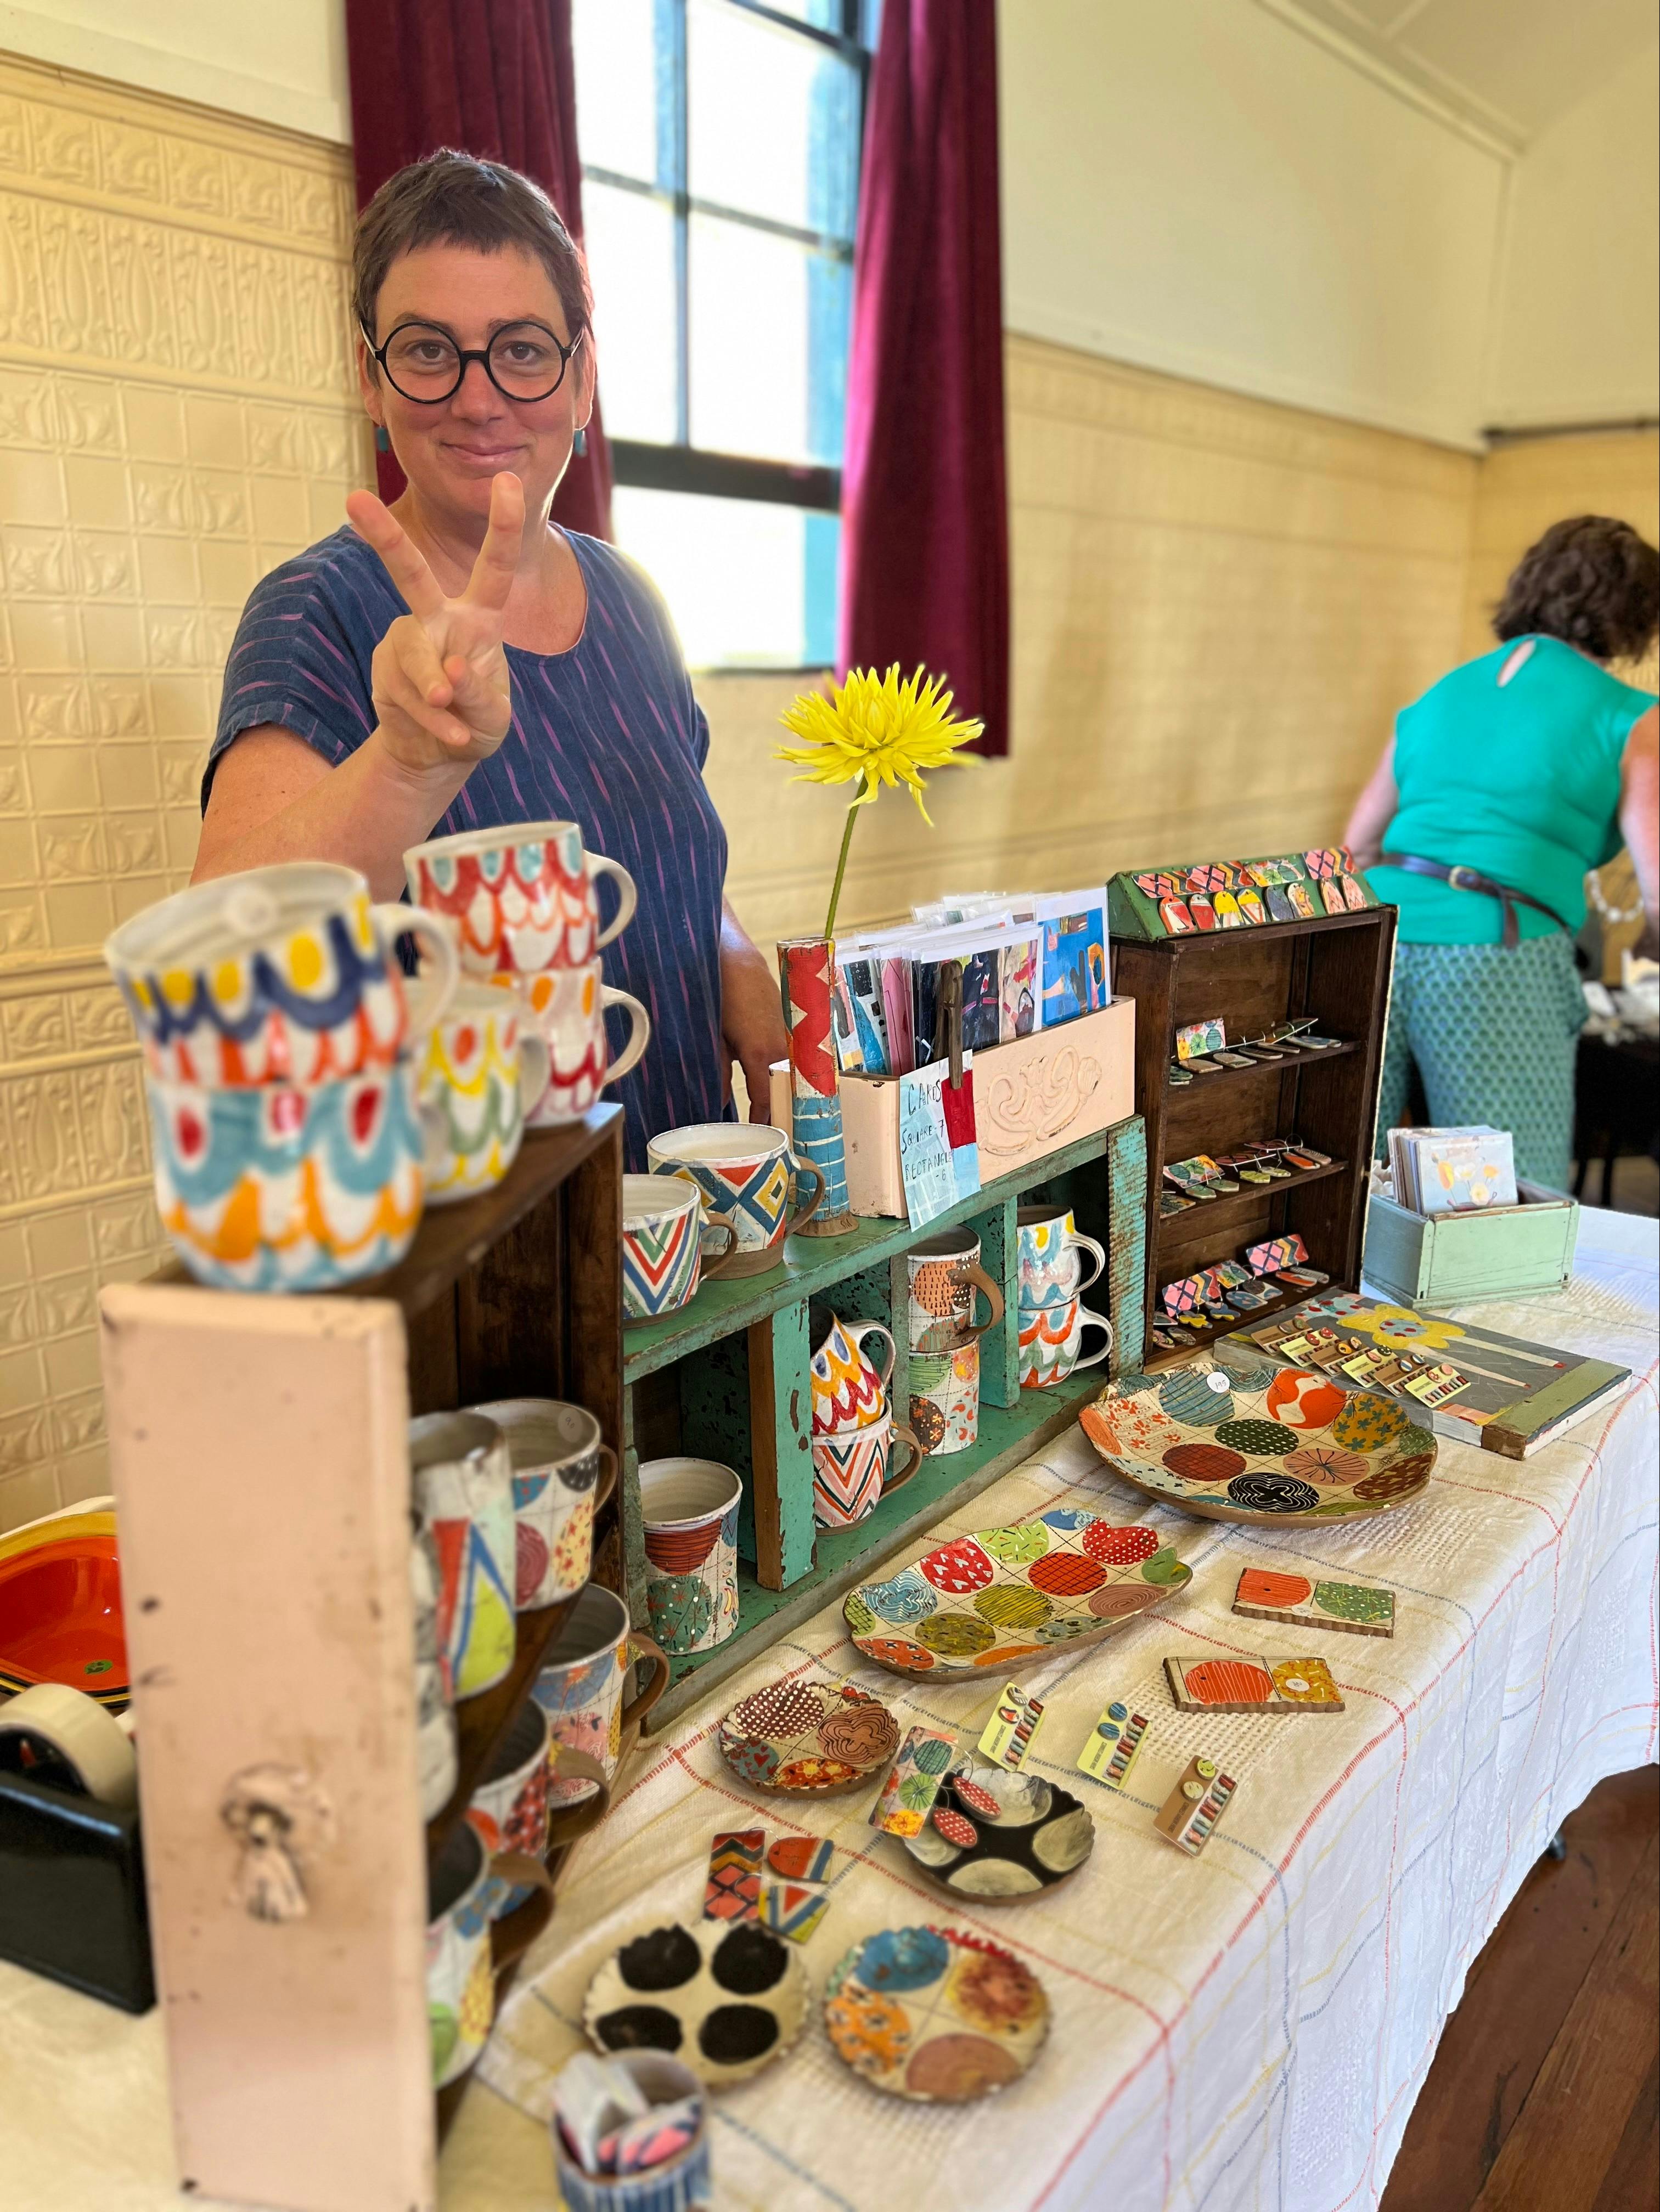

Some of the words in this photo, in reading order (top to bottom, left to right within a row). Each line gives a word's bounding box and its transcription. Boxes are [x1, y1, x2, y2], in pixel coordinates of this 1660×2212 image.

[908, 1079, 942, 1116] CARDS
[905, 1151, 952, 1182] RECTANGLE
[1214, 1380, 1226, 1390] 195
